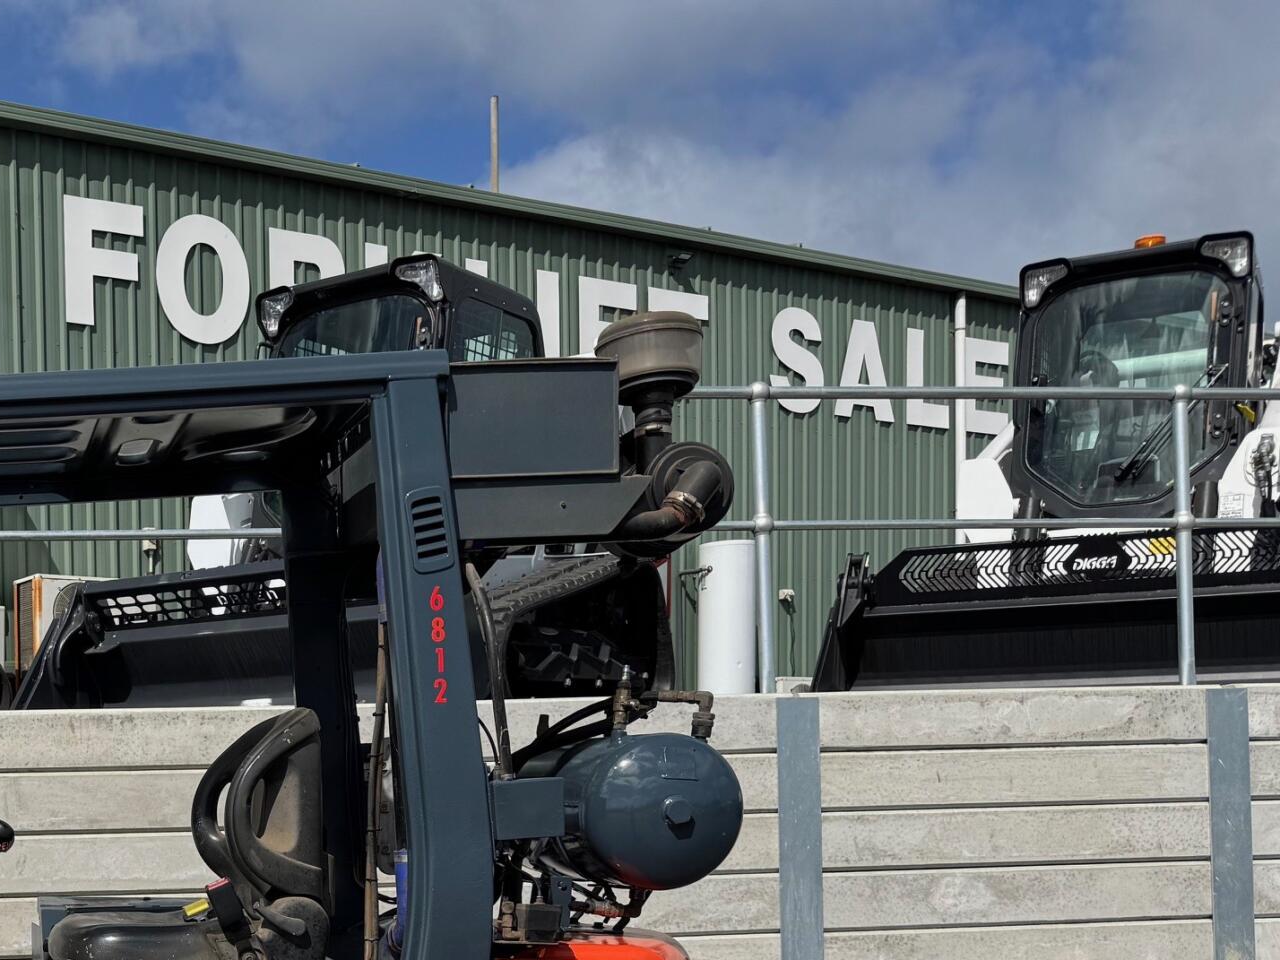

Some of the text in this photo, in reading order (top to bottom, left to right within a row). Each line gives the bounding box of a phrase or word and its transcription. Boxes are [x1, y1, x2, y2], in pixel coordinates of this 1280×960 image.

[770, 306, 1010, 436] SALE
[1072, 555, 1118, 571] DIGGA
[429, 585, 448, 704] 6812
